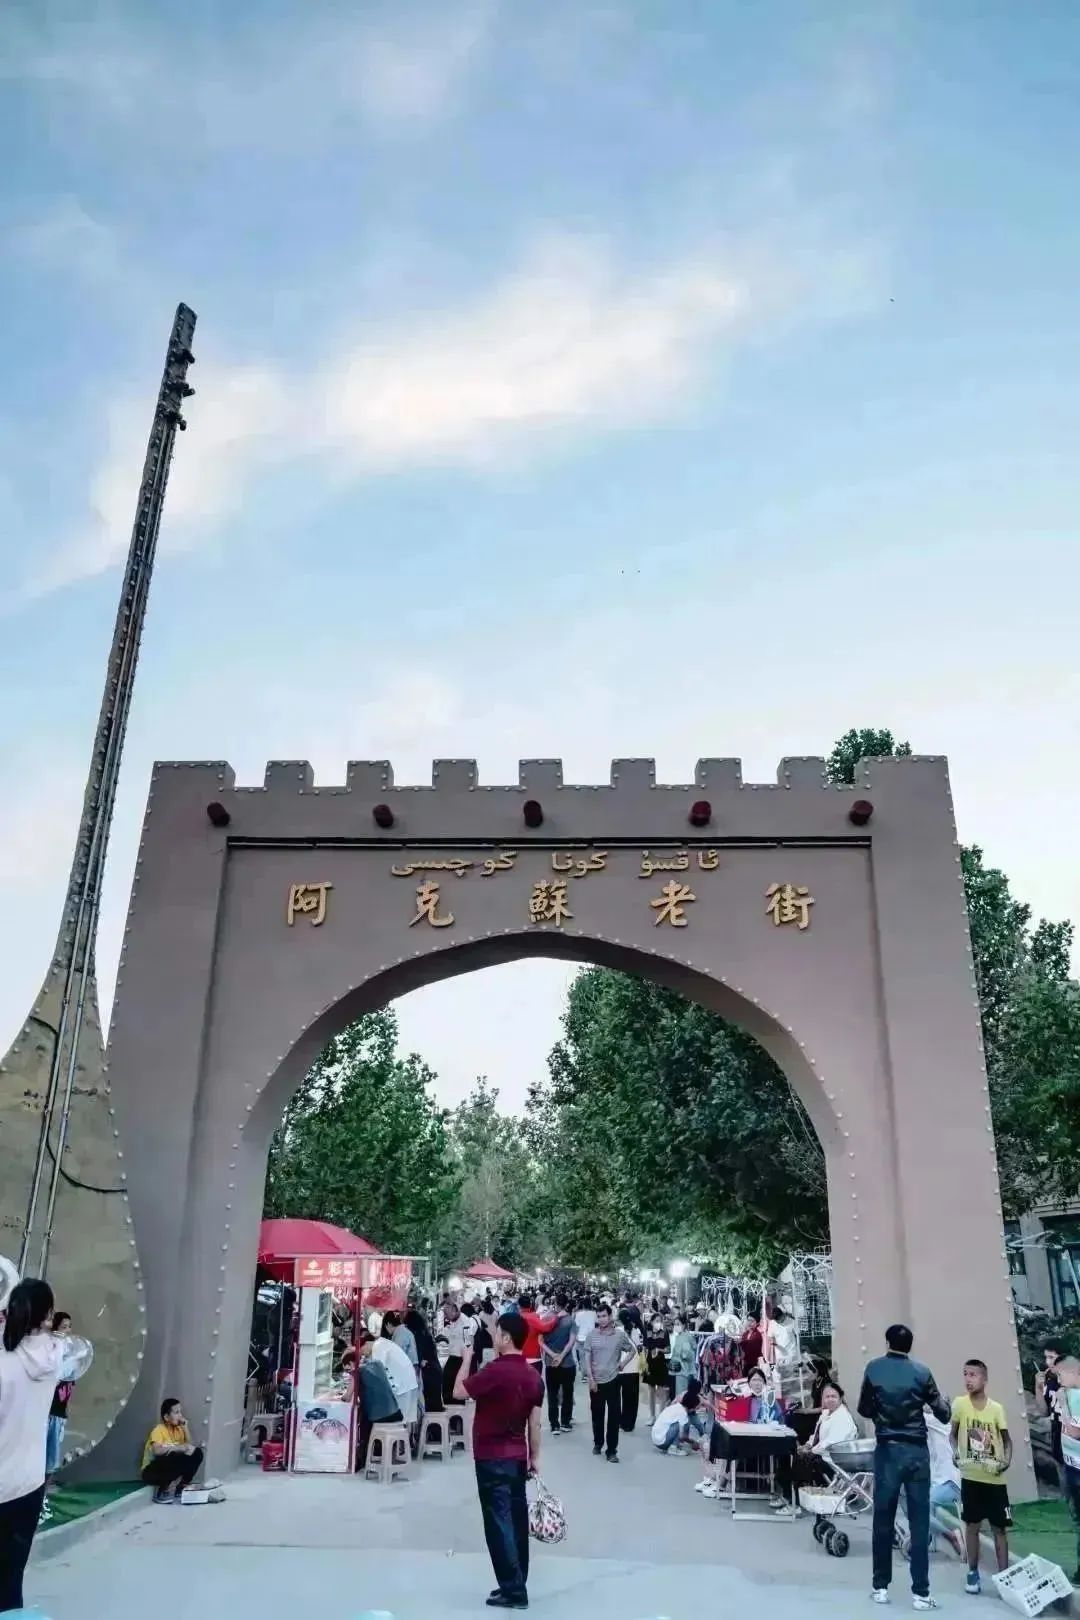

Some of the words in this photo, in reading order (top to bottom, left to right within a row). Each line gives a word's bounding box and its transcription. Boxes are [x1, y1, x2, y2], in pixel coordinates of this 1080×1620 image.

[551, 850, 608, 878] كونا
[287, 879, 815, 930] 阿克蘇老街
